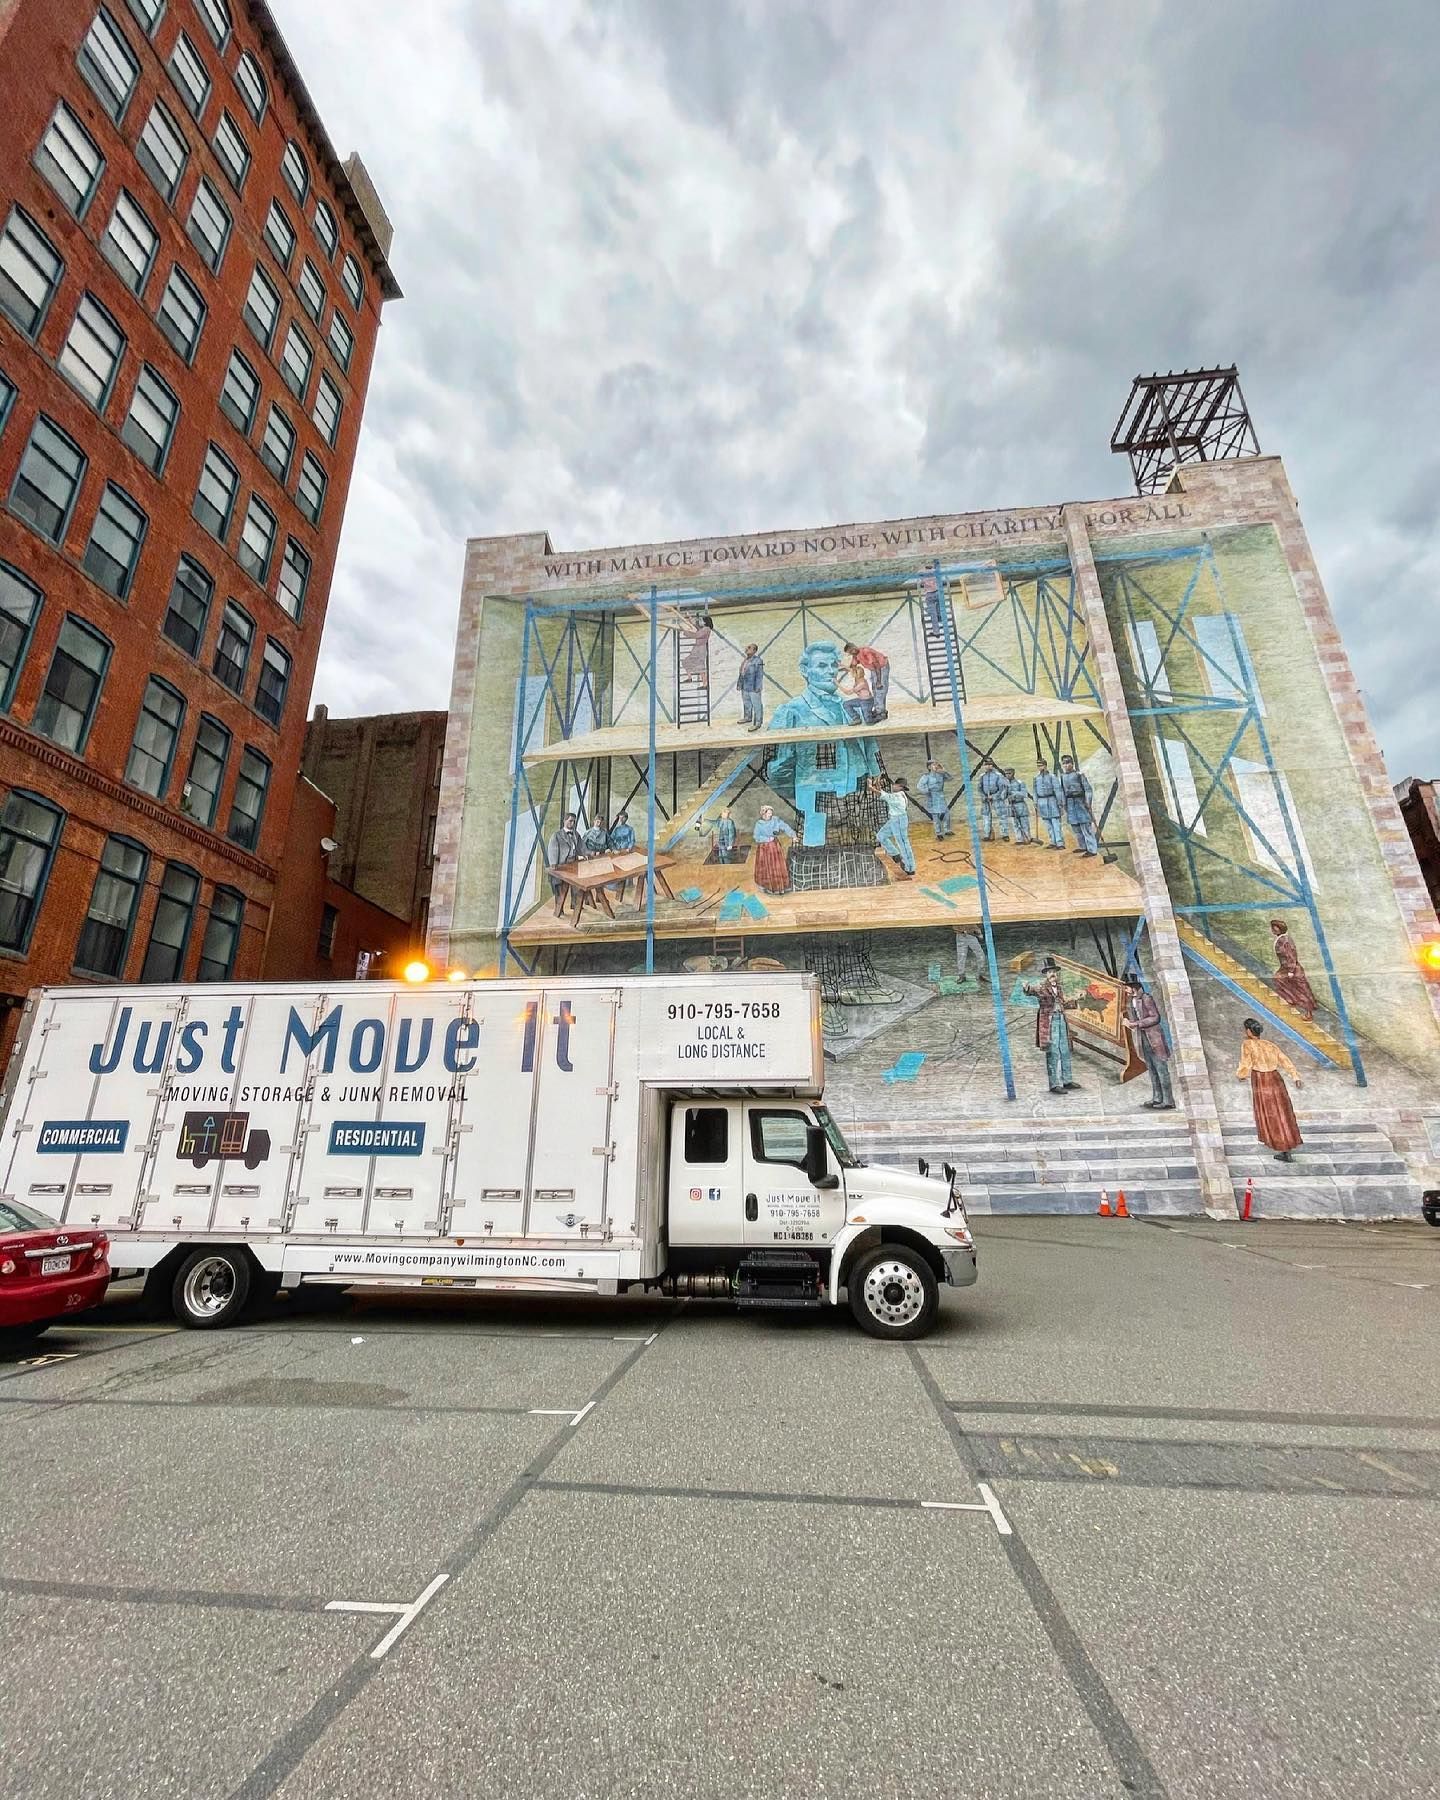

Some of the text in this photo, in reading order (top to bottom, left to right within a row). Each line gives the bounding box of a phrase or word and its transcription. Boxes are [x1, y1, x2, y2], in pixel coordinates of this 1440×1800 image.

[544, 502, 1193, 578] WITH MALICE TOWARD NONE, WITH CHARITY FOR ALL
[667, 1002, 781, 1020] 910-795-7658
[88, 1000, 577, 1075] Just Move It
[697, 1025, 745, 1040] LOCAL &
[678, 1043, 766, 1059] LONG DISTANCE
[166, 1086, 470, 1105] MOVING, STORAGE & JUNK REMOVAL
[42, 1128, 121, 1146] COMMERCIAL
[335, 1128, 418, 1148] RESIDENTIAL
[766, 1193, 785, 1204] Just
[787, 1194, 811, 1204] Move
[770, 1209, 821, 1218] 910-795-7658
[334, 1252, 566, 1269] www.MovingcompanywilmingtonNC.com
